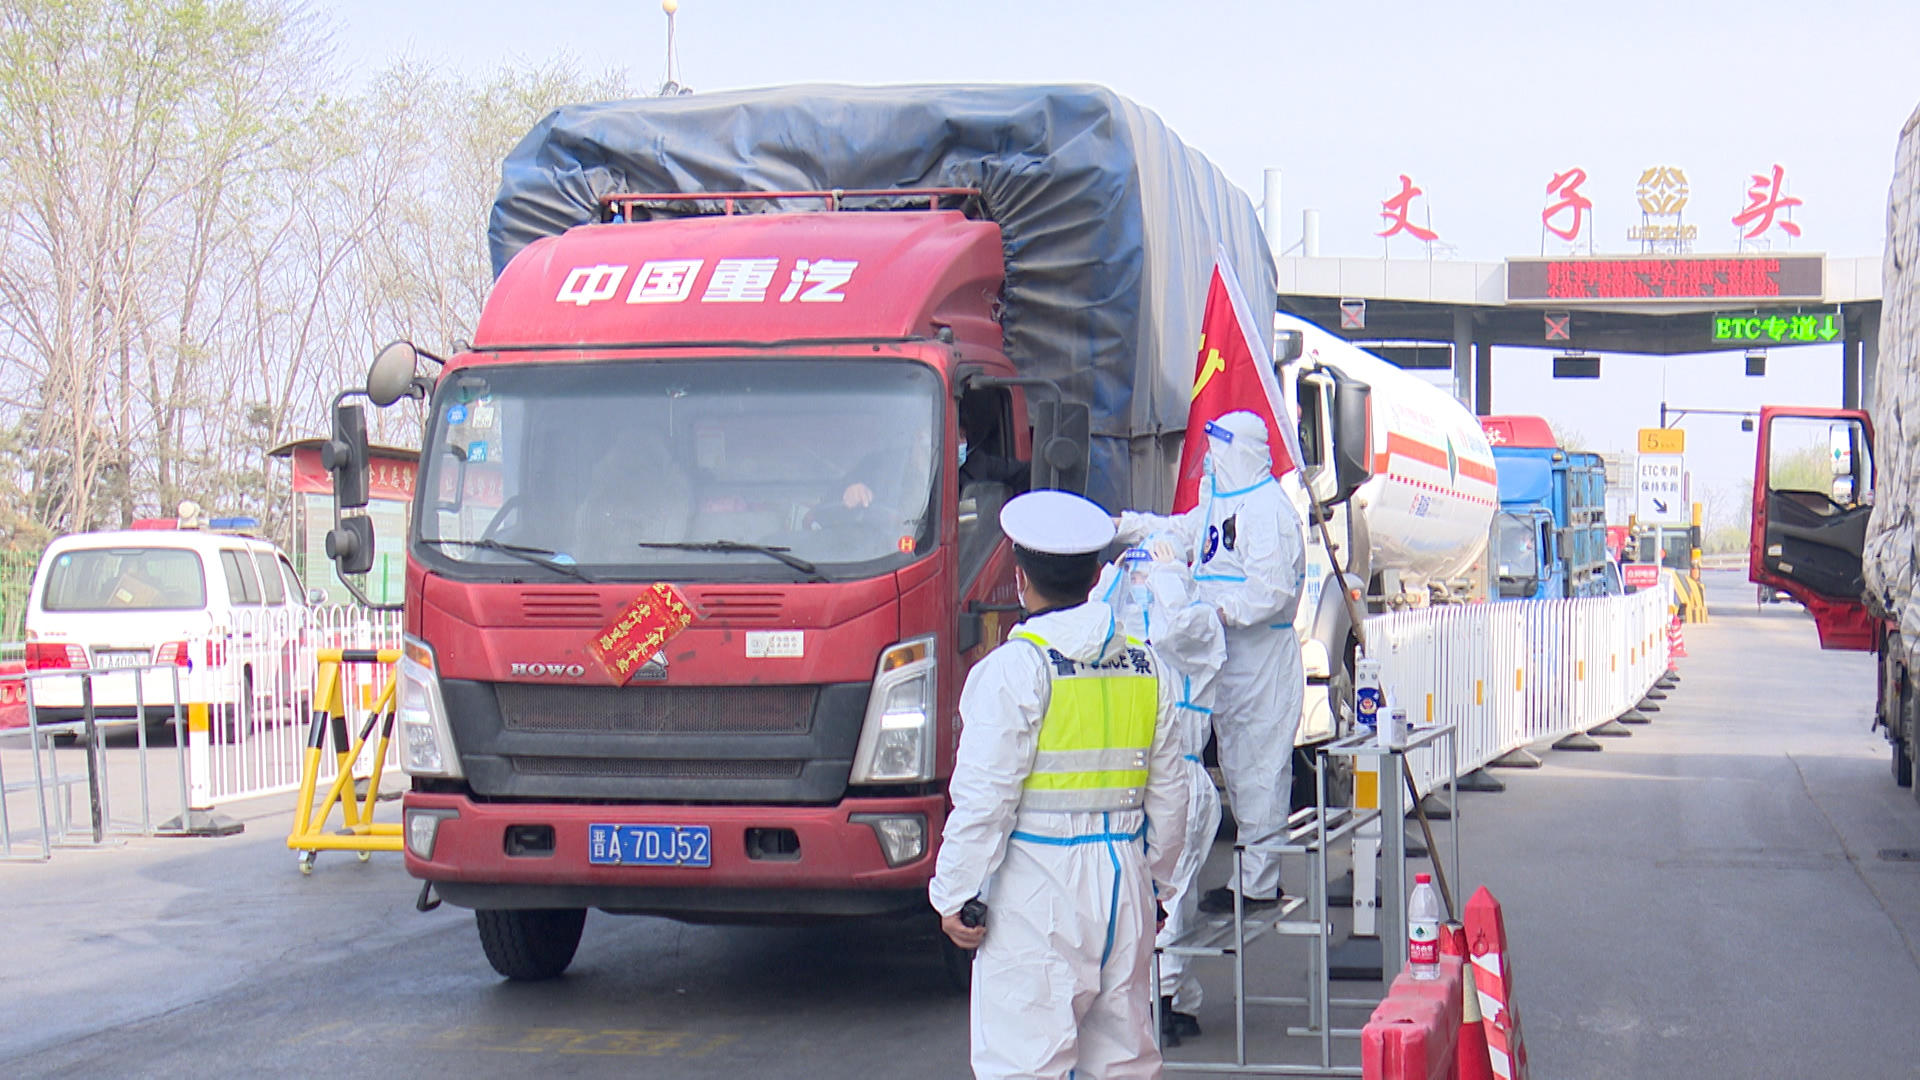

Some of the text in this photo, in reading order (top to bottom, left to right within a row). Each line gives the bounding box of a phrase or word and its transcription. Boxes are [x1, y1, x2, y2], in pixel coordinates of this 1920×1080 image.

[555, 257, 859, 305] 中国重汽
[511, 662, 585, 677] HOWO
